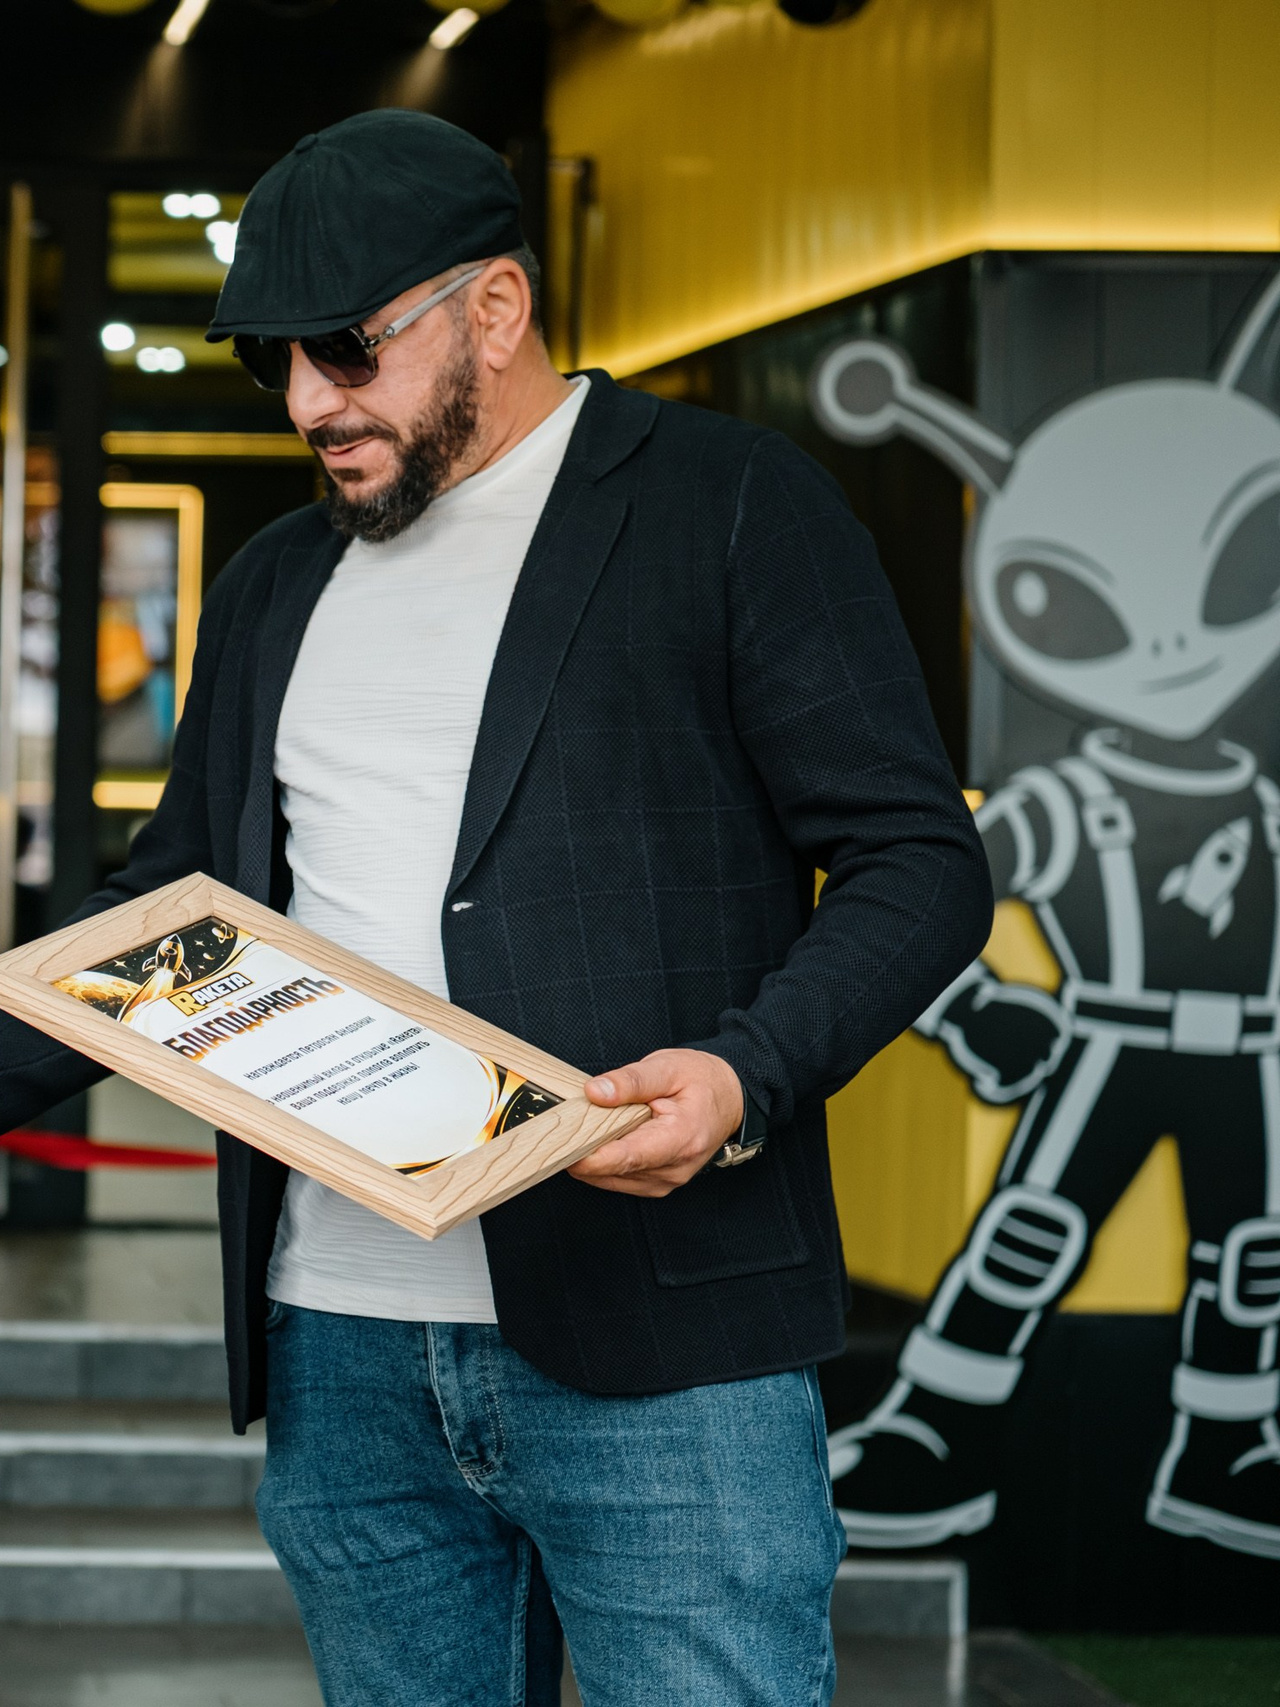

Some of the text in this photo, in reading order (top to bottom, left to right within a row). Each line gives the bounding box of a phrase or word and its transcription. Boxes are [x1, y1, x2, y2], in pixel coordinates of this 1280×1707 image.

[162, 977, 345, 1062] БЛАГОДАРНОСТЬ
[243, 1051, 303, 1080] Награждается
[298, 1033, 339, 1055] Петросян
[271, 1074, 324, 1102] неоценимый
[321, 1063, 351, 1078] вклад
[351, 1042, 390, 1063] открытие
[290, 1040, 430, 1110] Ваша поддержка помогла воплотить
[336, 1091, 363, 1105] нашу
[359, 1079, 387, 1095] мечту
